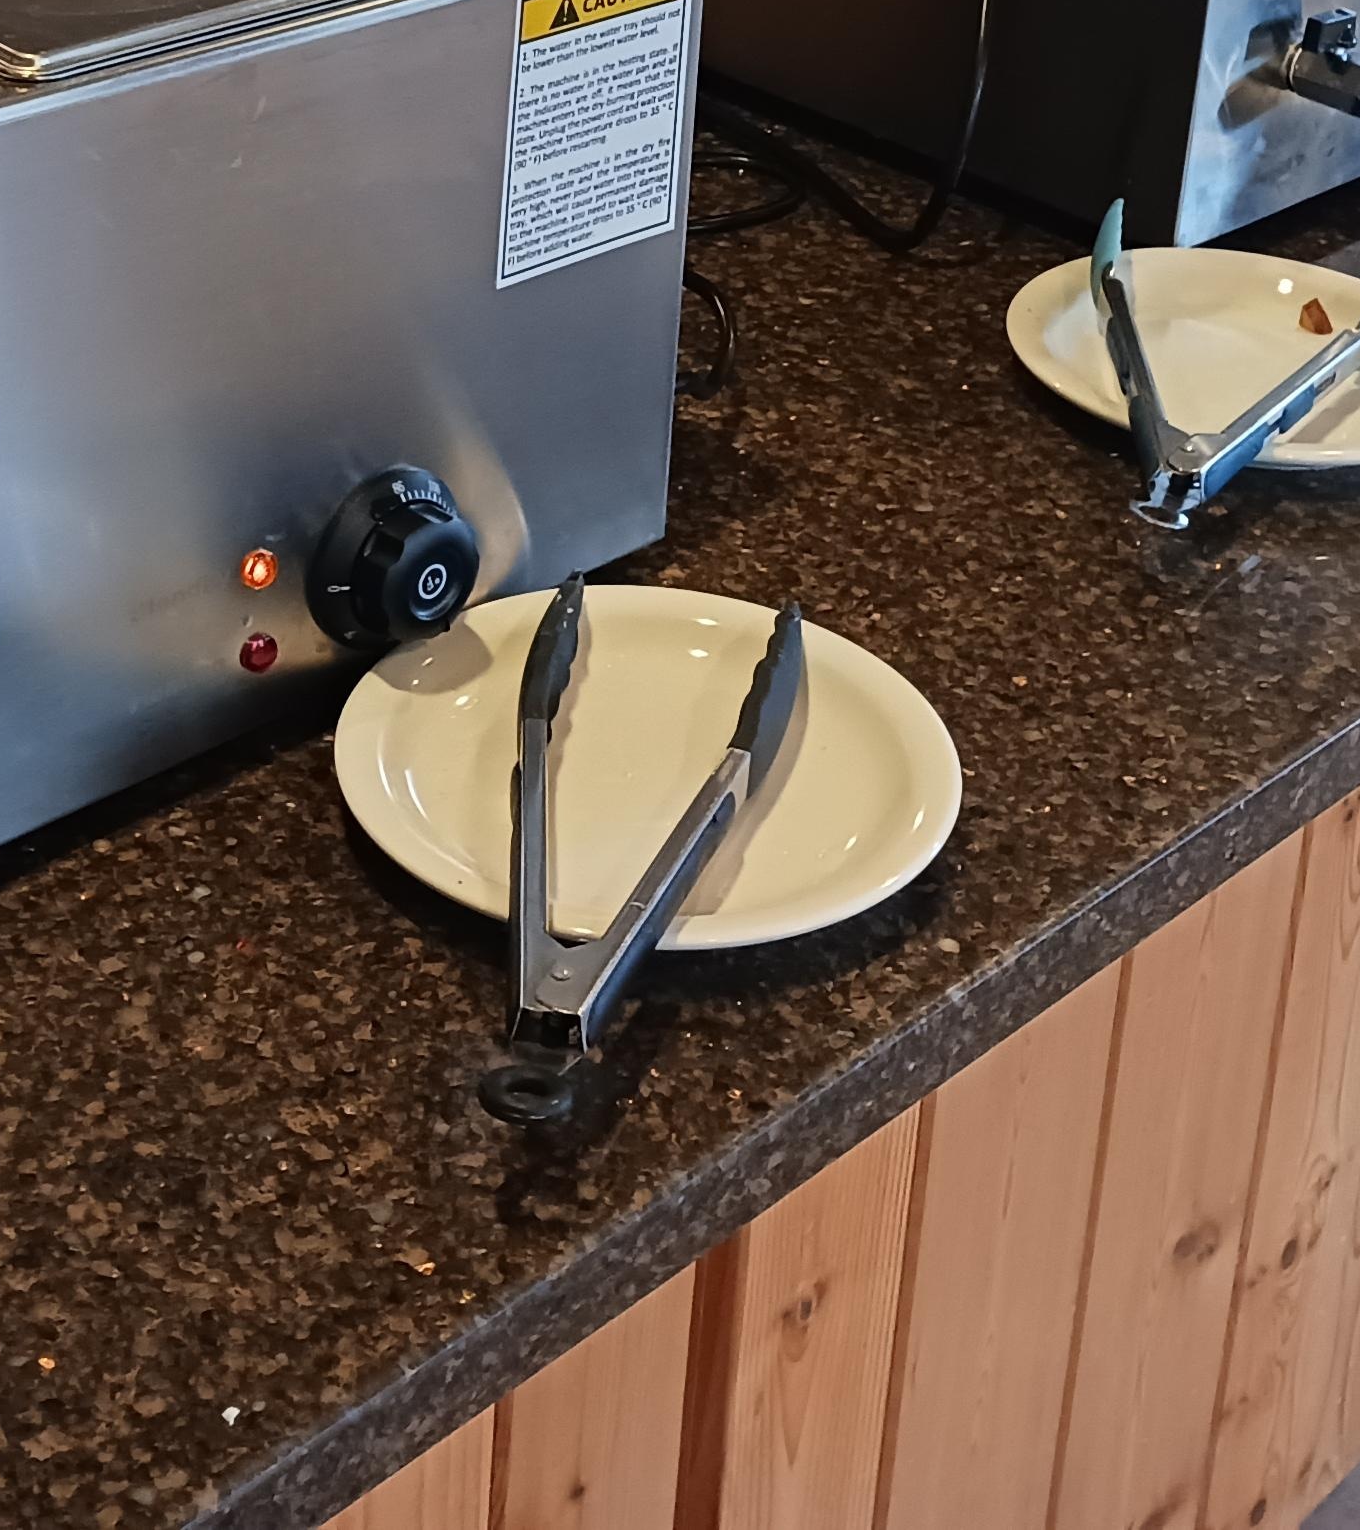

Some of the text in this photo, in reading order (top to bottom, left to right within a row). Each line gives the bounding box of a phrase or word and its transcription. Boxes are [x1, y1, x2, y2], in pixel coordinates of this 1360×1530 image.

[532, 48, 547, 57] The
[549, 40, 571, 52] water
[584, 33, 597, 42] the
[599, 25, 621, 37] water
[623, 22, 638, 31] tray
[641, 11, 665, 26] should
[667, 8, 680, 18] not
[532, 57, 555, 69] lower
[556, 51, 574, 62] than
[575, 47, 588, 56] the
[590, 38, 615, 52] lowest
[616, 32, 638, 44] water
[517, 112, 530, 122] the
[533, 100, 571, 116] indicators
[575, 94, 587, 104] are
[616, 78, 641, 90] means
[644, 71, 660, 83] that
[663, 68, 675, 77] the
[518, 97, 539, 109] there
[562, 84, 585, 95] water
[596, 76, 609, 85] the
[611, 69, 633, 80] water
[635, 64, 649, 75] pan
[651, 58, 666, 69] and
[530, 84, 544, 94] The
[547, 73, 579, 88] machine
[602, 63, 615, 72] the
[516, 118, 549, 133] machine
[551, 110, 575, 123] enters
[577, 105, 590, 115] the
[591, 102, 604, 110] dry
[636, 80, 675, 97] protection
[567, 120, 580, 129] the
[581, 112, 605, 125] power
[606, 105, 623, 117] cord
[625, 100, 638, 111] and
[640, 95, 656, 106] wait
[514, 148, 527, 158] the
[530, 137, 563, 152] machine
[565, 121, 613, 141] temperature
[615, 114, 637, 126] drops
[542, 148, 568, 161] before
[510, 152, 660, 207] protection state and the temperature
[523, 177, 546, 189] When
[551, 171, 564, 181] the
[568, 160, 600, 175] machine
[625, 148, 638, 157] the
[641, 143, 654, 152] dry
[658, 138, 670, 146] fire
[510, 208, 527, 218] very
[549, 192, 571, 203] never
[593, 178, 614, 190] water
[633, 168, 646, 177] the
[647, 161, 668, 172] water
[519, 228, 532, 238] the
[618, 193, 634, 204] wait
[655, 184, 667, 192] the
[530, 209, 552, 222] which
[595, 182, 636, 201] permanent
[508, 237, 540, 253] machine
[542, 220, 590, 241] temperature
[516, 248, 541, 262] before
